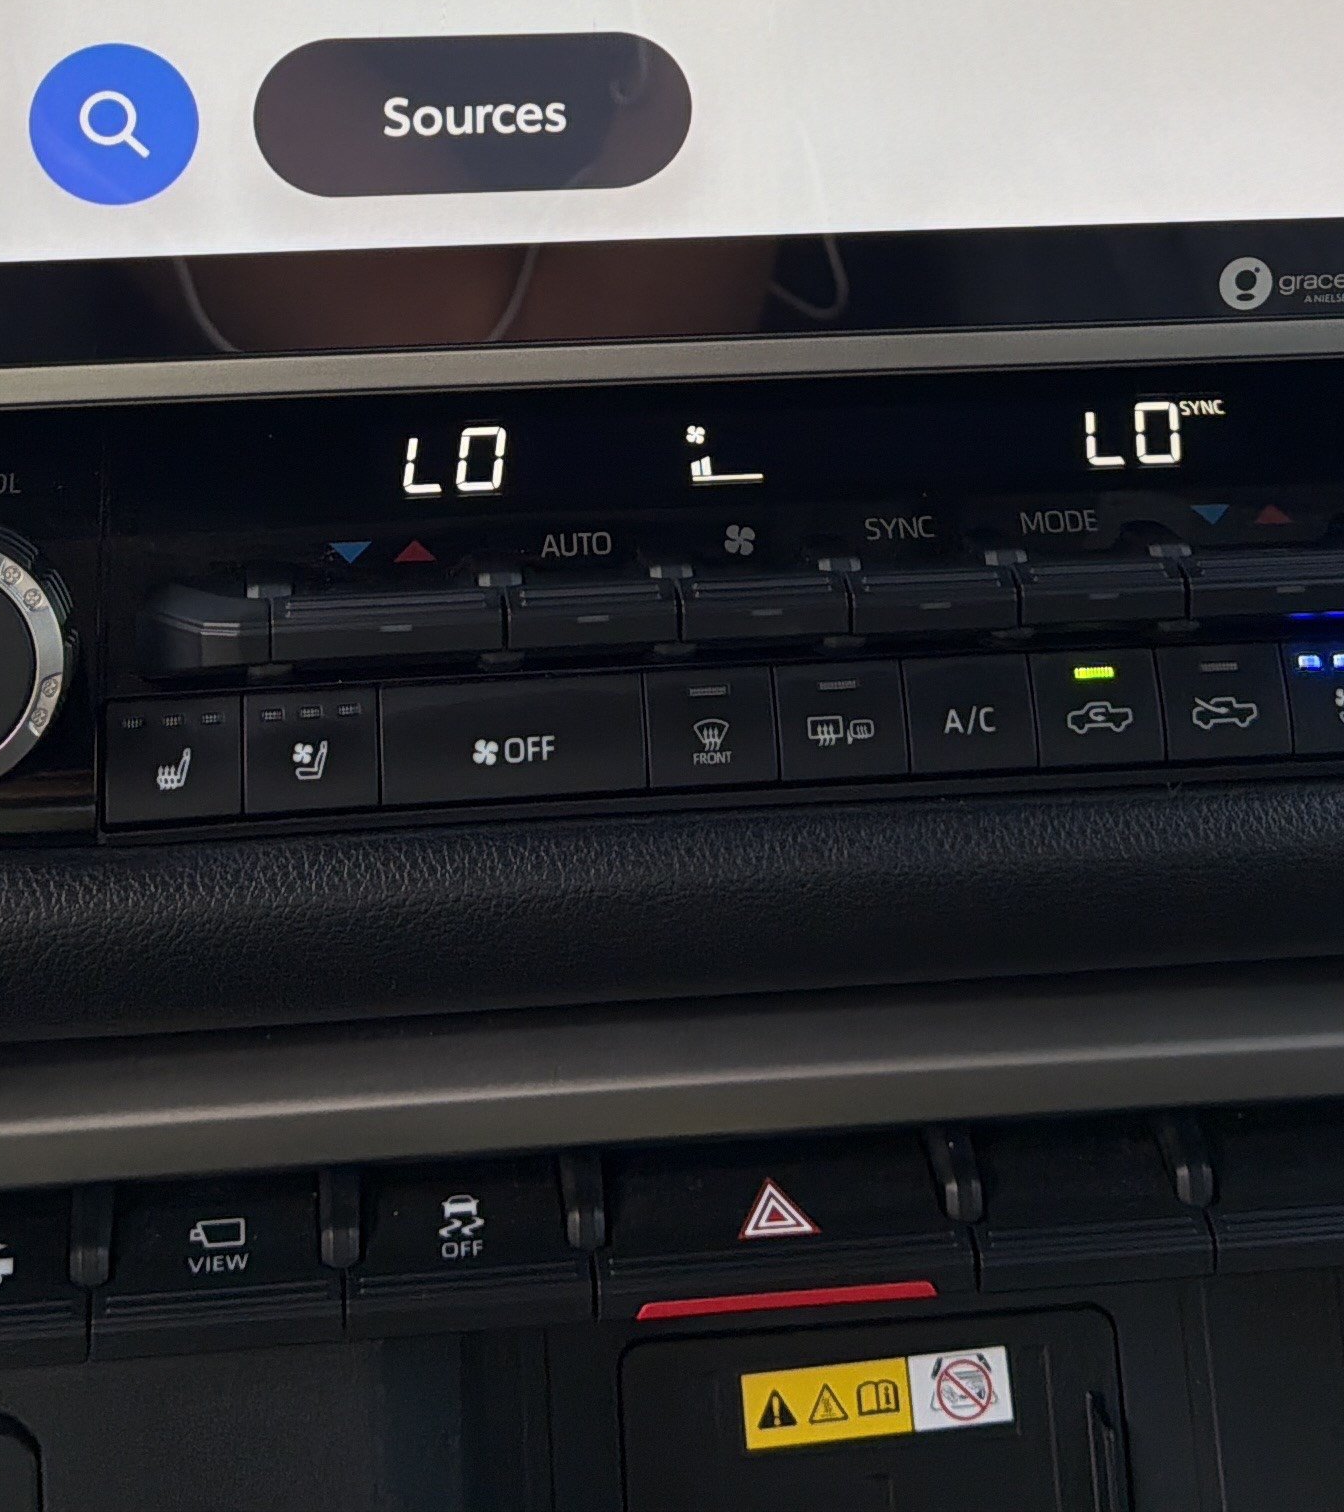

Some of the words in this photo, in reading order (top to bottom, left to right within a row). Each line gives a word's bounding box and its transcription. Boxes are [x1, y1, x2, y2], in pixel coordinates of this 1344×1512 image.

[382, 96, 568, 138] Sources
[1179, 399, 1227, 416] SYNC
[864, 515, 936, 541] SYNC
[1019, 508, 1099, 536] MODE
[540, 531, 613, 558] AUTO
[944, 706, 997, 735] A/C
[503, 735, 556, 763] OFF
[692, 750, 733, 766] FRONT
[440, 1239, 485, 1259] OFF
[187, 1253, 249, 1274] VIEW
